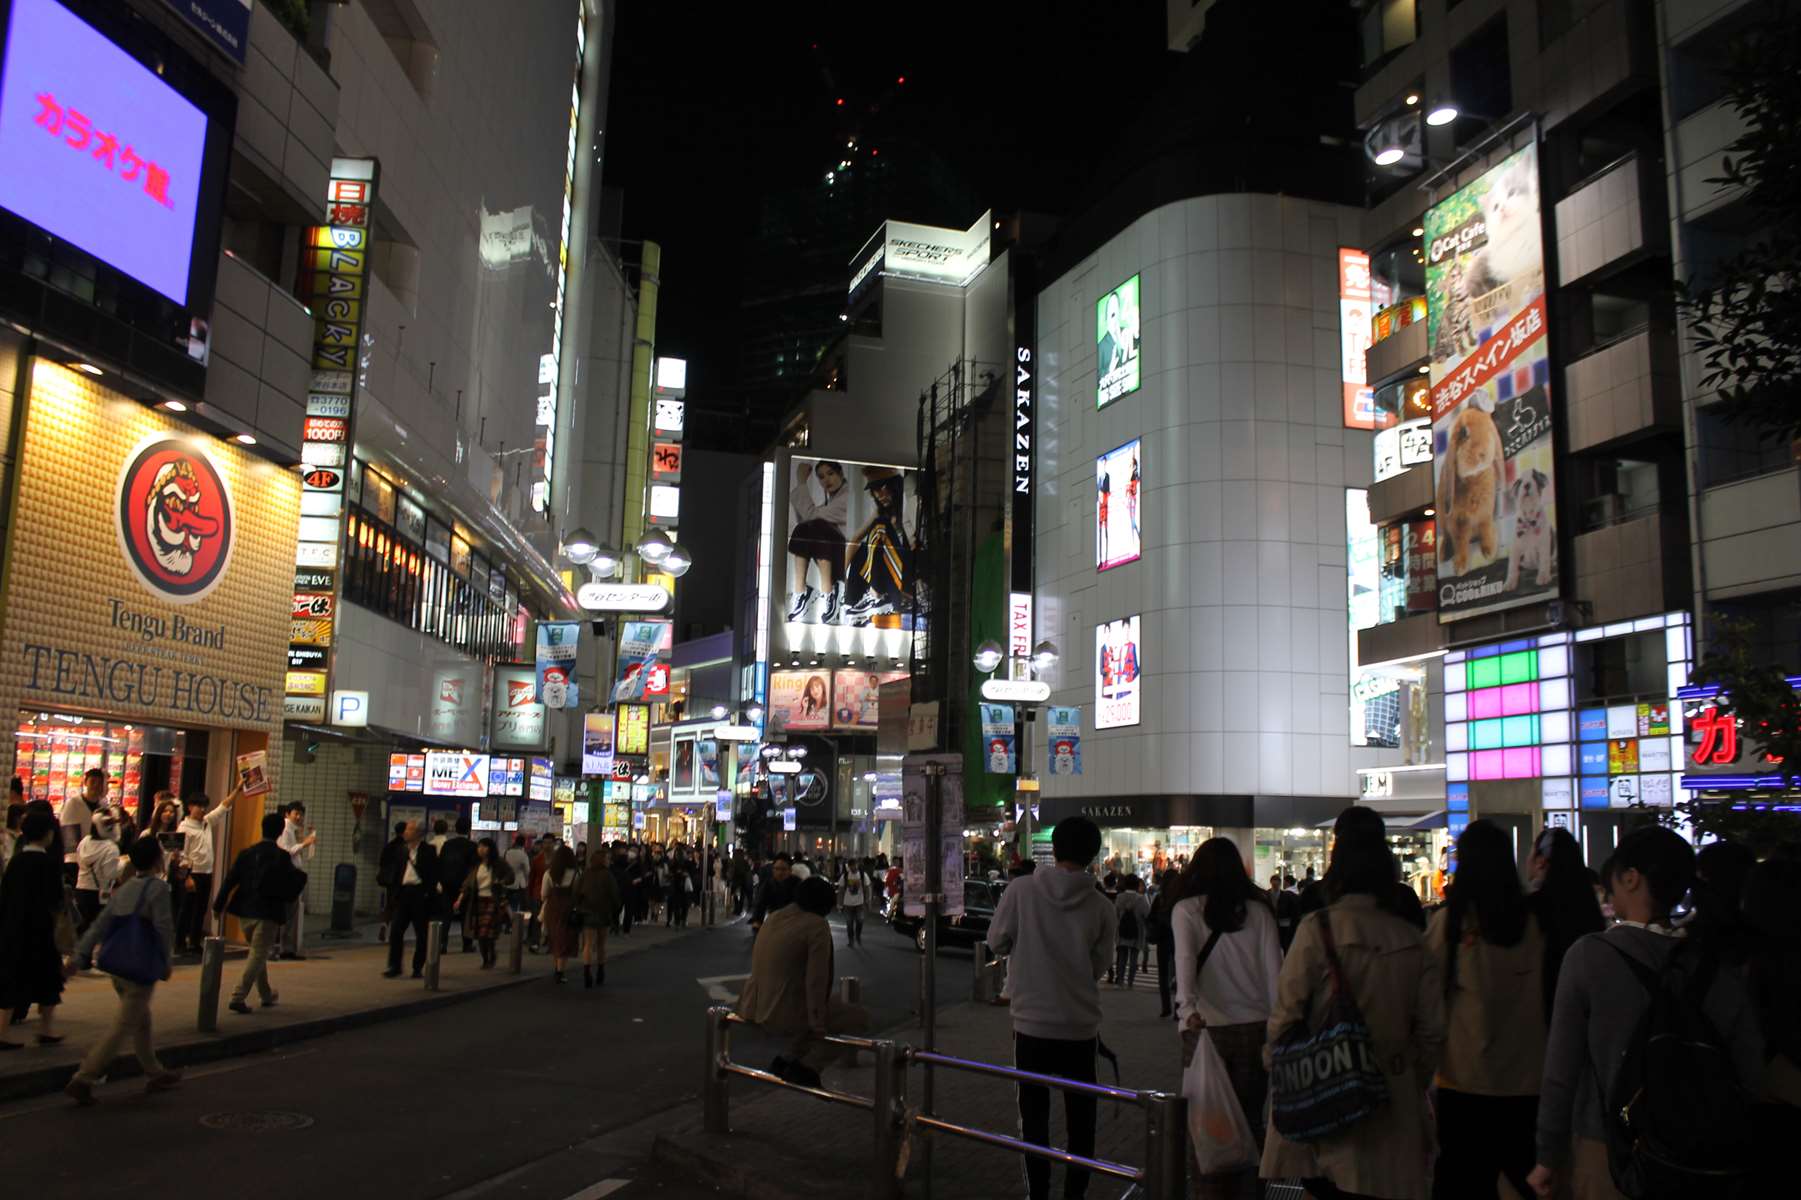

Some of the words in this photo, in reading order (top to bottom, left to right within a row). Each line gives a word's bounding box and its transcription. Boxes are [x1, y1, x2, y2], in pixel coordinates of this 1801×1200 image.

[889, 240, 963, 256] SKECHERS
[894, 249, 950, 263] SPORT
[1436, 307, 1543, 413] 渋谷スペイン坂店
[1013, 346, 1032, 495] SAKAZEN
[307, 471, 333, 488] 4F
[311, 574, 332, 586] EVE
[108, 598, 166, 642] Tengu
[171, 613, 225, 650] Brand
[1013, 603, 1028, 631] TAX
[23, 643, 161, 707] TENGU
[170, 670, 273, 722] HOUSE
[340, 697, 361, 721] P
[1080, 805, 1133, 817] SAKAZEN
[1273, 1040, 1353, 1093] ONDON
